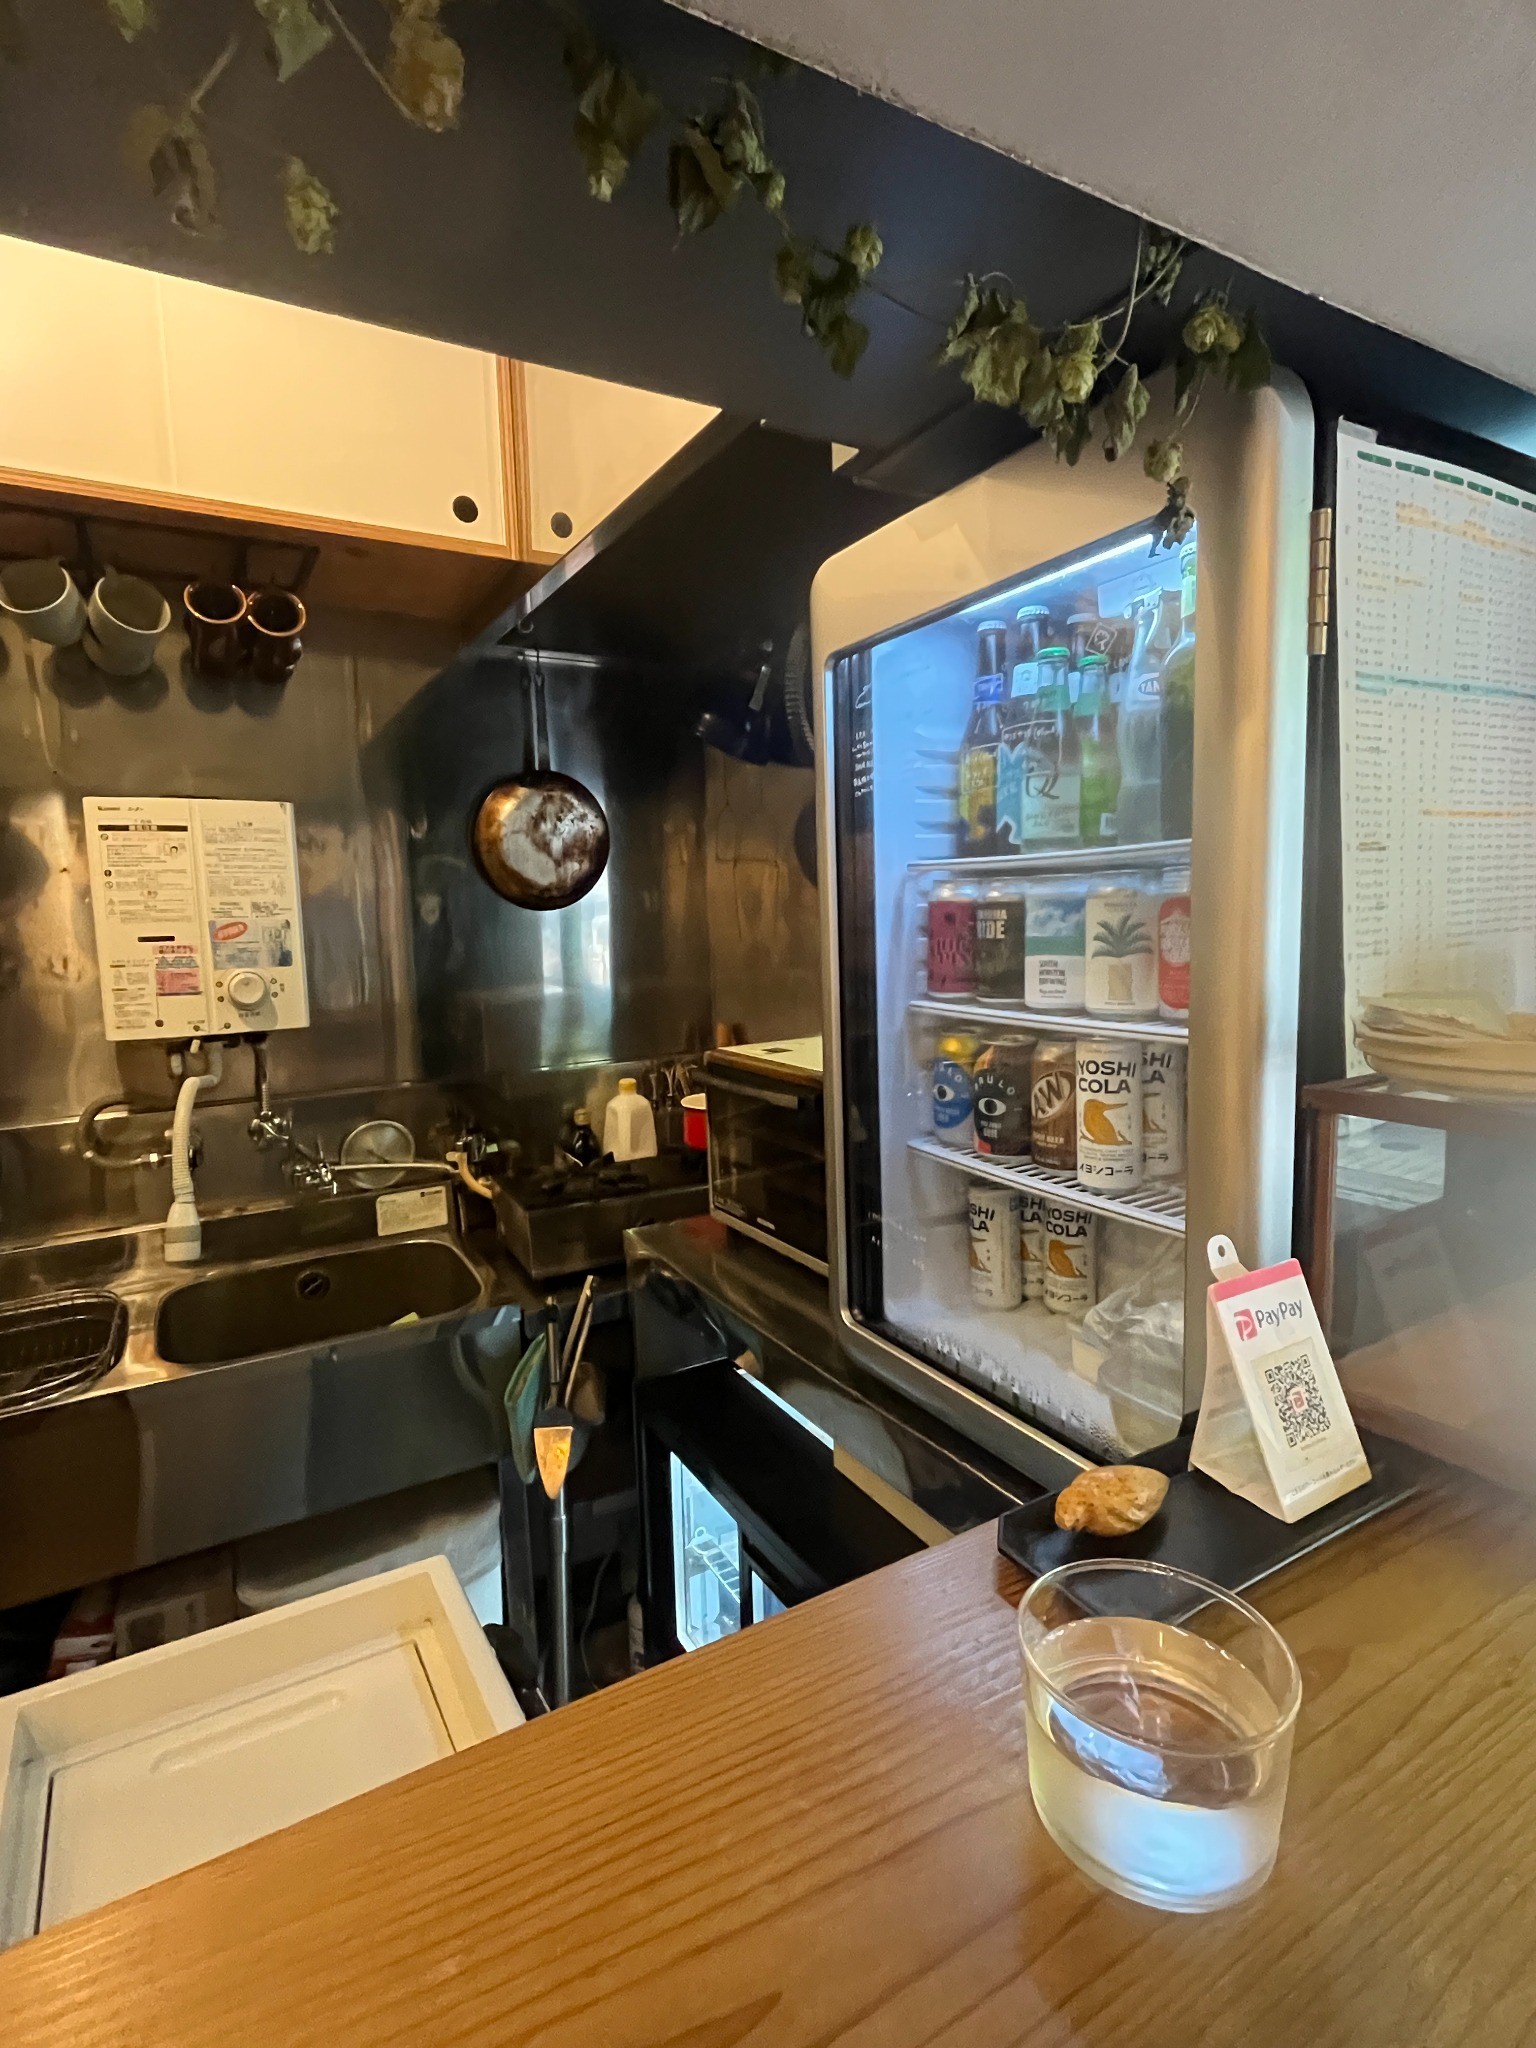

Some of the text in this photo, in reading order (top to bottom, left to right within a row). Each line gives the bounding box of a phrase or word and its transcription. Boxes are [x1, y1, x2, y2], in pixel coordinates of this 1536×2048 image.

[1077, 1059, 1137, 1078] YOSHI
[1078, 1077, 1132, 1095] COLA
[1046, 1206, 1093, 1224] YOSHI
[1045, 1220, 1088, 1238] COLA
[1254, 1299, 1303, 1328] PayPay
